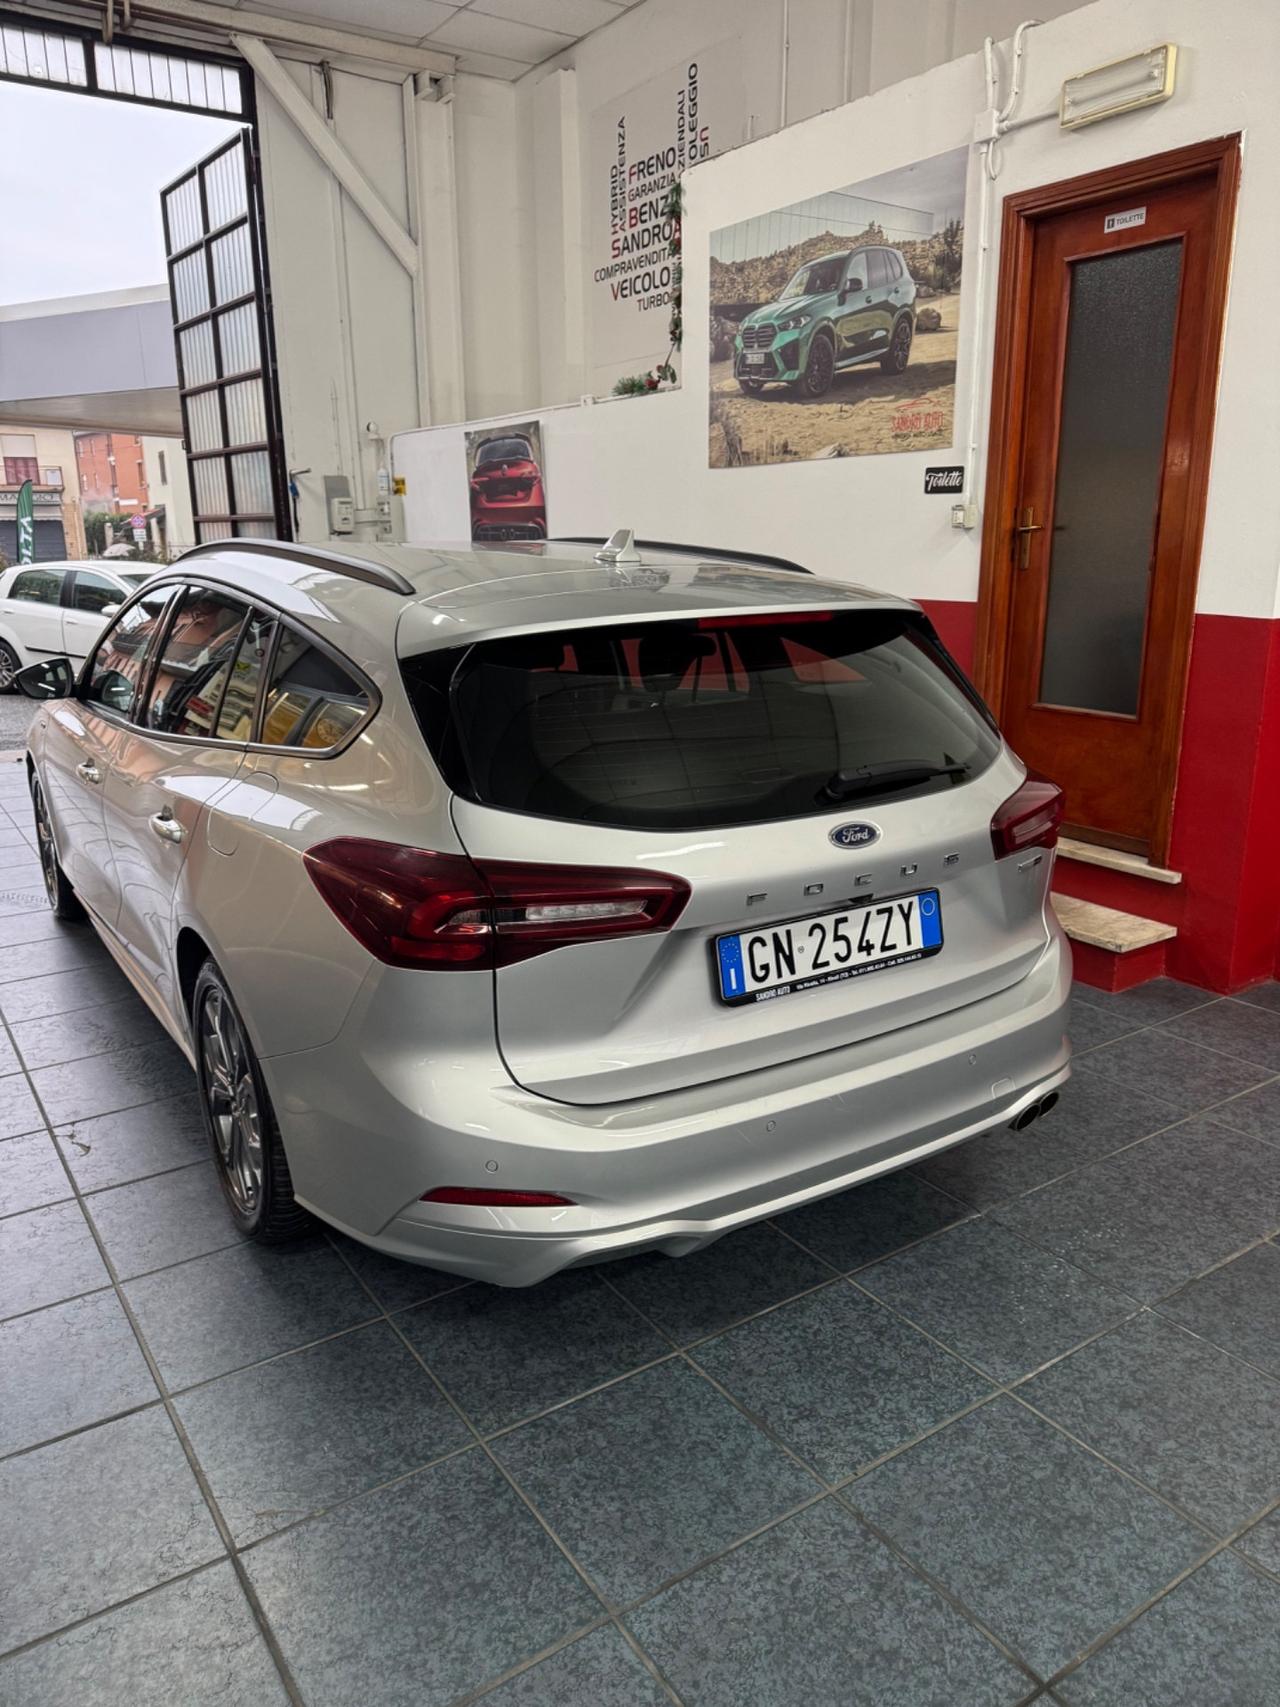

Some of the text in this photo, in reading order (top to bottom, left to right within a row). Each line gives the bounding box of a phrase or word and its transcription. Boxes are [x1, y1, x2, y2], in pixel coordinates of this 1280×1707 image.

[688, 63, 698, 163] OLEGGIO
[618, 116, 626, 232] ASSISTENZA
[629, 147, 676, 184] FRENO
[610, 165, 619, 235] HYBRID
[628, 172, 676, 201] GARANZIA
[1116, 213, 1144, 225] TOILETTE
[612, 221, 672, 259] SANDRO
[611, 266, 670, 301] VEICOLO
[926, 471, 962, 491] Toilette
[842, 827, 869, 843] Ford
[747, 853, 959, 906] FOCUS
[748, 929, 796, 983] GN
[808, 901, 914, 970] 254ZY
